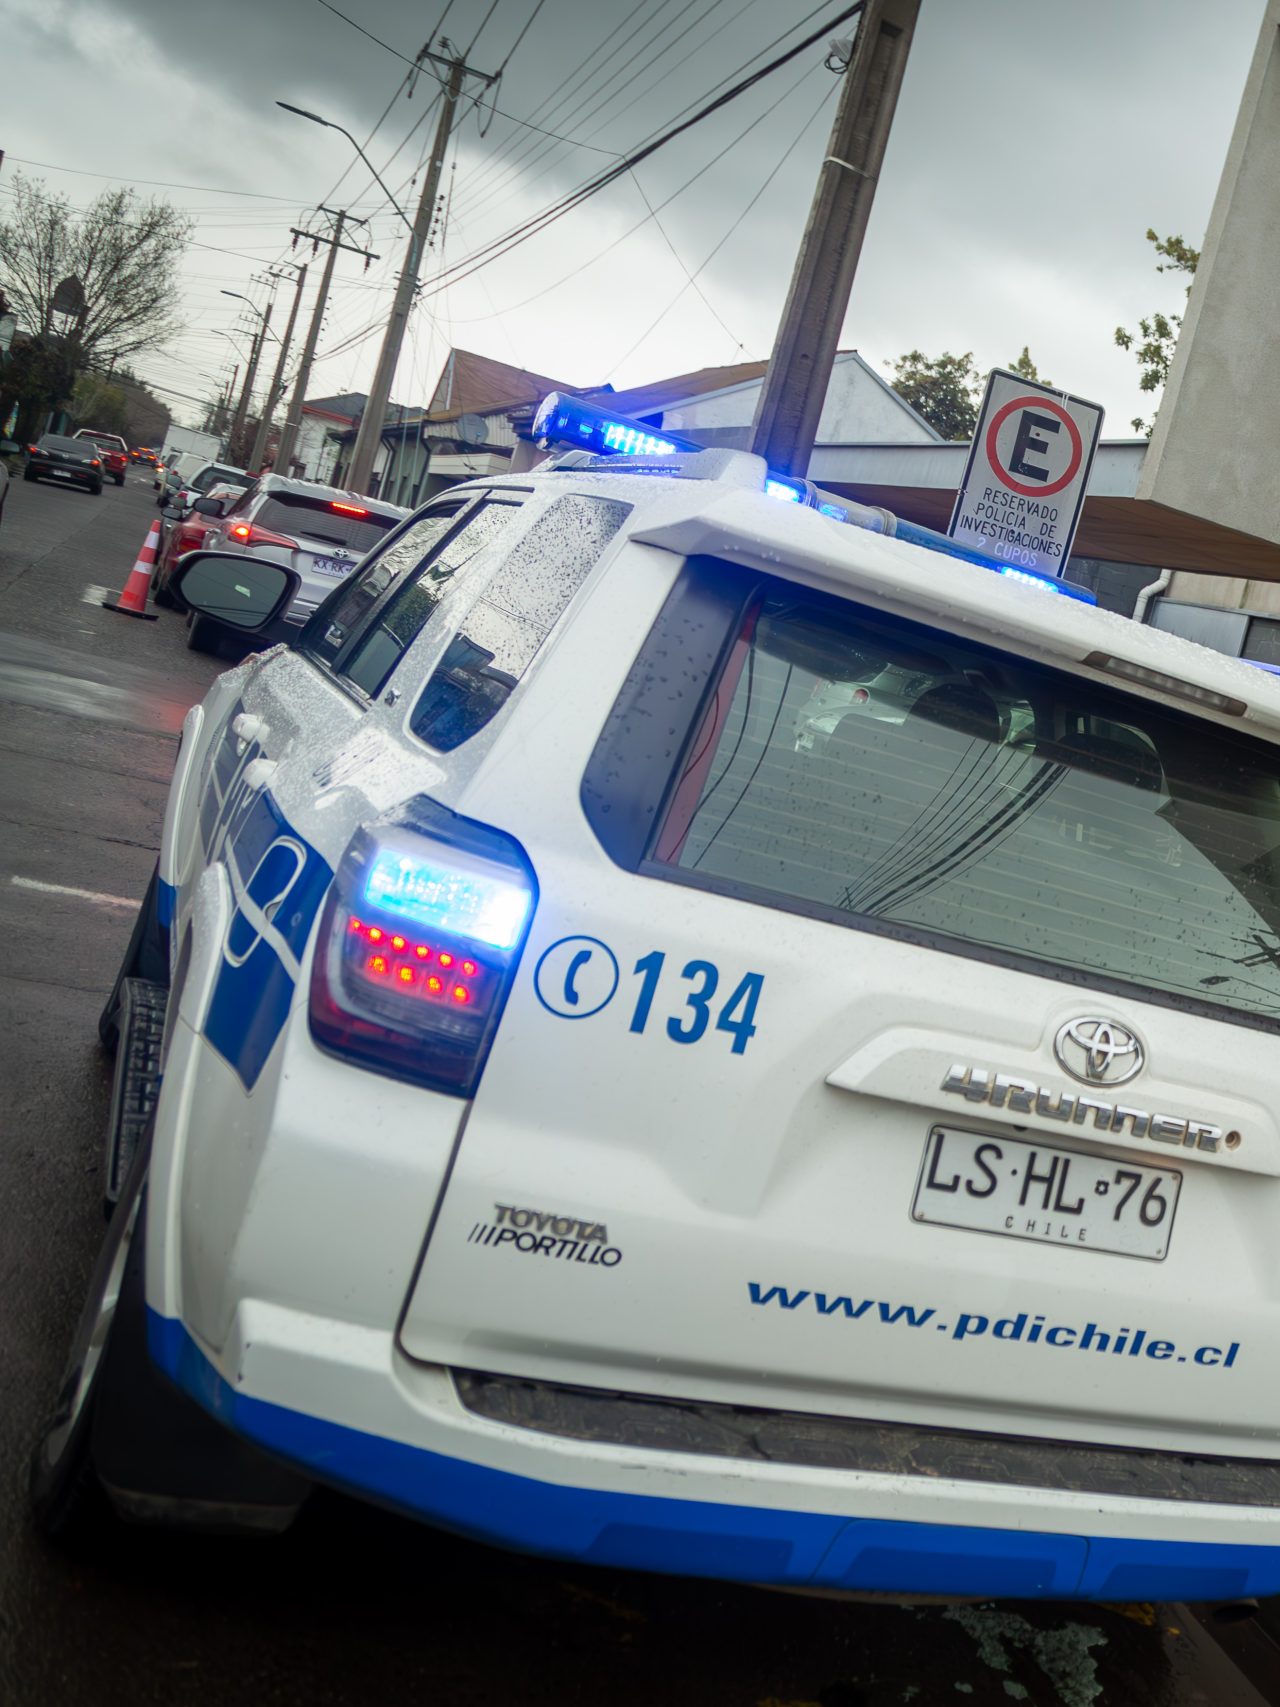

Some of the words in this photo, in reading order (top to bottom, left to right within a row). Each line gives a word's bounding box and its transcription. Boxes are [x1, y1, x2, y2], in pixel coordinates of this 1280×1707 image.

[1009, 410, 1061, 483] E
[973, 502, 1026, 530] POLICIA
[982, 487, 1058, 522] RESERVADO
[960, 514, 1063, 557] INVESTIGACIONES
[1039, 522, 1057, 539] DE
[994, 541, 1039, 567] CUPOS
[629, 950, 765, 1055] 134
[494, 1201, 608, 1245] TOYOTA
[1004, 1215, 1087, 1242] CHILE
[492, 1226, 622, 1267] PORTILLO
[746, 1281, 1240, 1369] www.pdichile.cl
